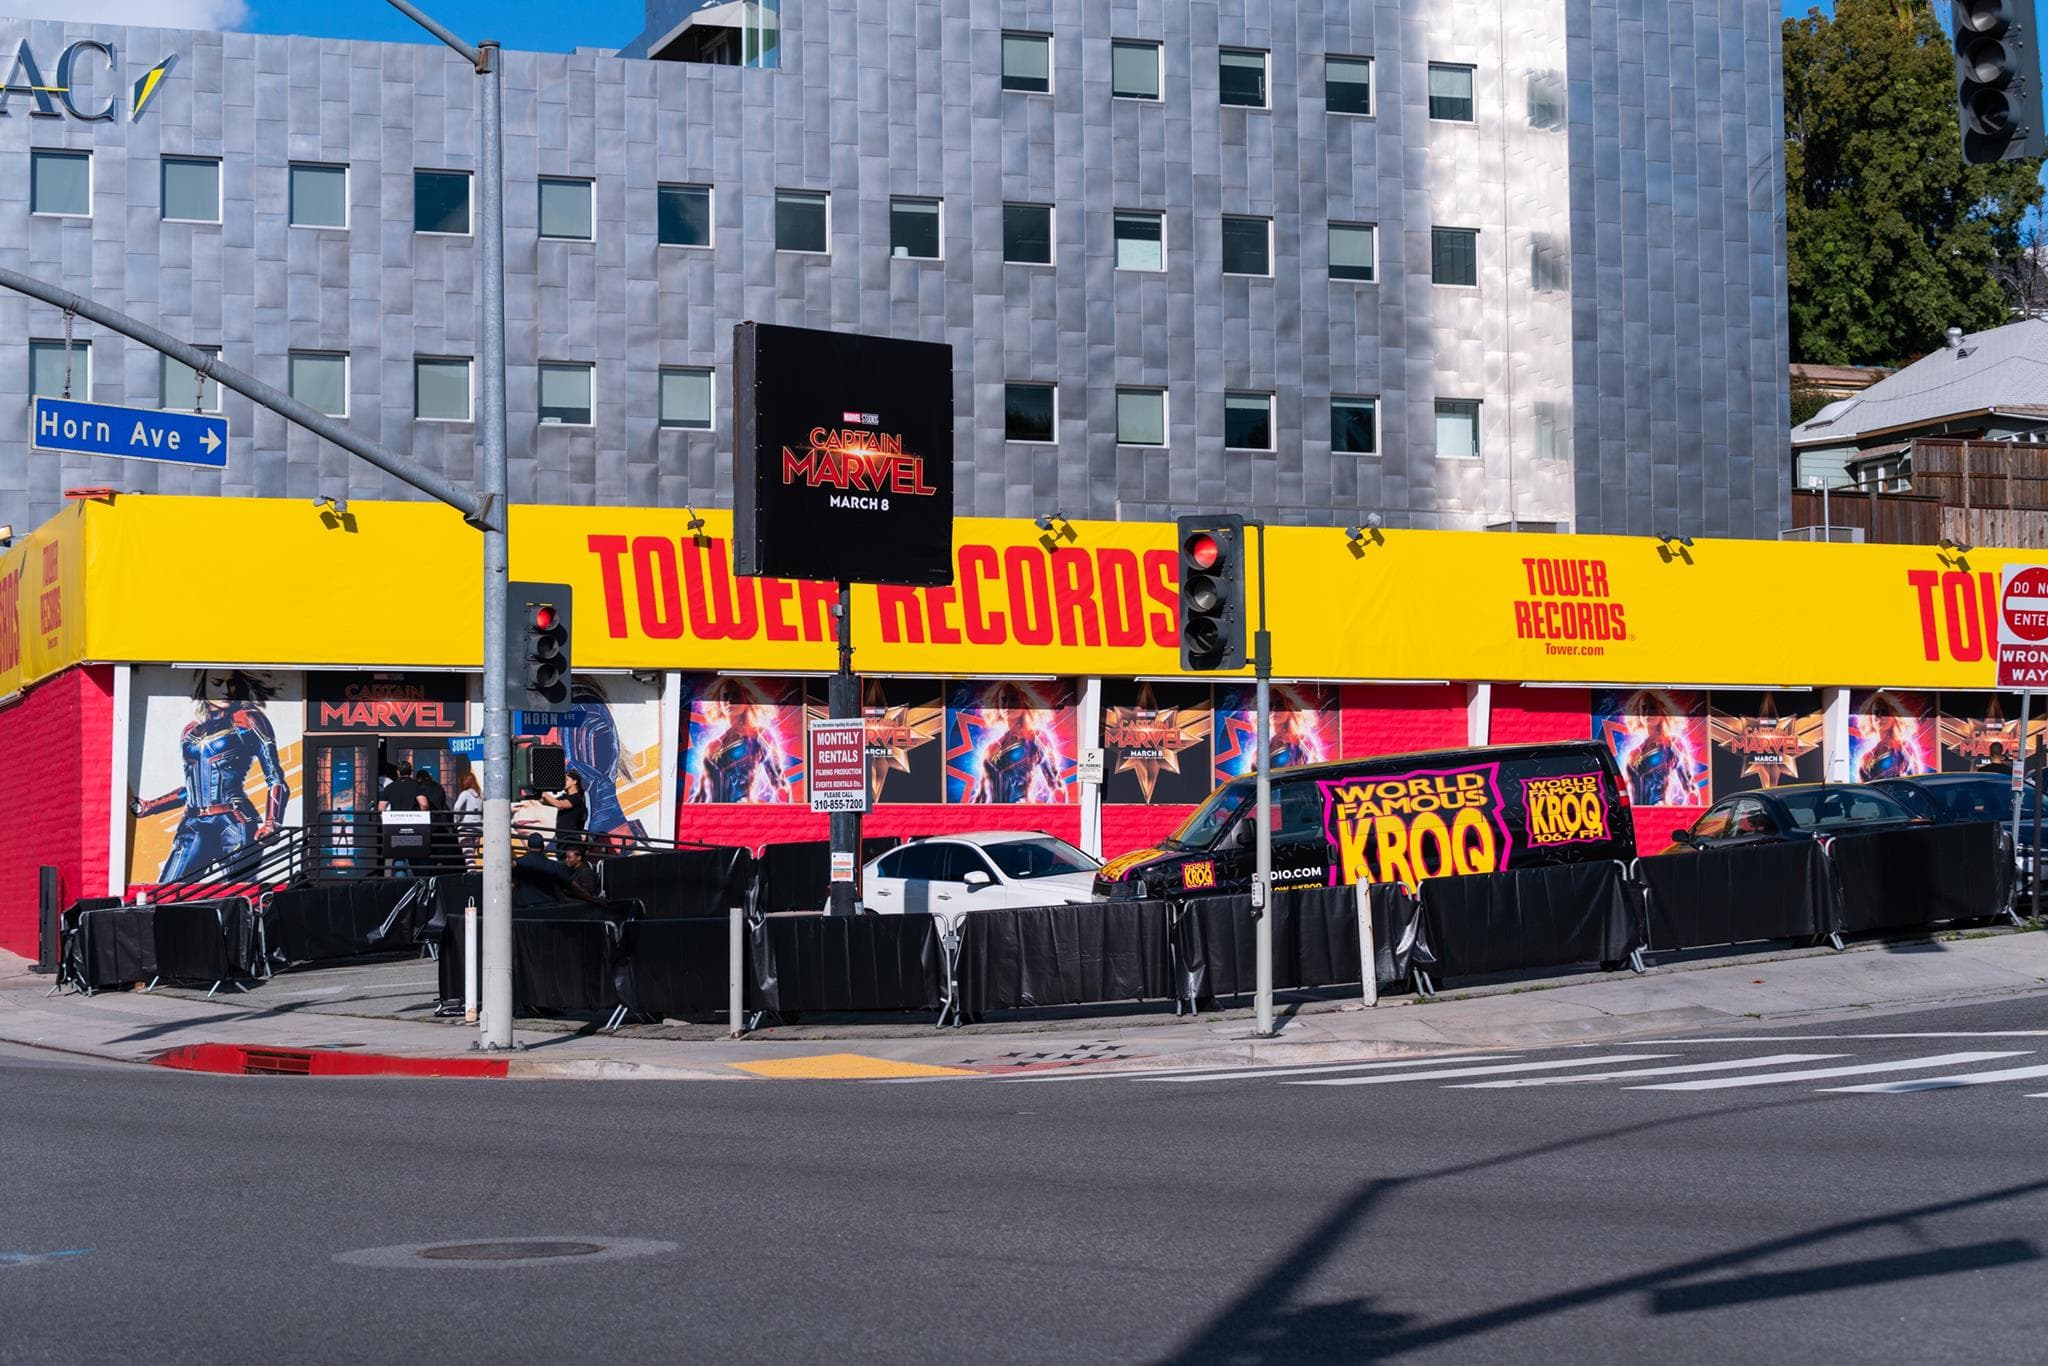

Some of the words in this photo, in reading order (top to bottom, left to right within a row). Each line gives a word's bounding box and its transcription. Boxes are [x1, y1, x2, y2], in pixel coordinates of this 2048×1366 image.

[41, 410, 110, 442] Horn
[130, 421, 181, 450] Ave
[809, 426, 902, 454] CAPTAIN
[782, 446, 937, 496] MARVEL
[829, 494, 878, 511] MARCH
[880, 499, 890, 512] 8
[1521, 557, 1610, 598] TOWER
[2013, 581, 2030, 594] DO
[1514, 601, 1627, 641] RECORDS
[2014, 613, 2048, 627] ENTE
[1545, 642, 1604, 656] Tower.com
[2012, 668, 2048, 682] WAY
[345, 683, 425, 700] CAPTAIN
[320, 701, 456, 727] MARVEL
[523, 712, 558, 725] HORN
[451, 739, 475, 752] SUNSET
[817, 731, 859, 746] MONTHLY
[1105, 727, 1184, 749] MARVEL
[1731, 735, 1801, 754] MARVEL
[819, 750, 858, 763] RENTALS
[834, 767, 862, 776] PRODUCTION
[833, 780, 853, 788] RENTALS
[1335, 773, 1486, 803] WORLD
[1528, 776, 1597, 790] WORLD
[1529, 784, 1598, 798] FAMOUS
[814, 799, 863, 810] 310-855-7200
[1336, 790, 1488, 821] FAMOUS
[1530, 792, 1604, 834] KROQ
[1534, 832, 1575, 843] 106.7
[1580, 829, 1603, 838] FM
[1337, 807, 1496, 895] KROQ
[1184, 868, 1213, 887] KROQ
